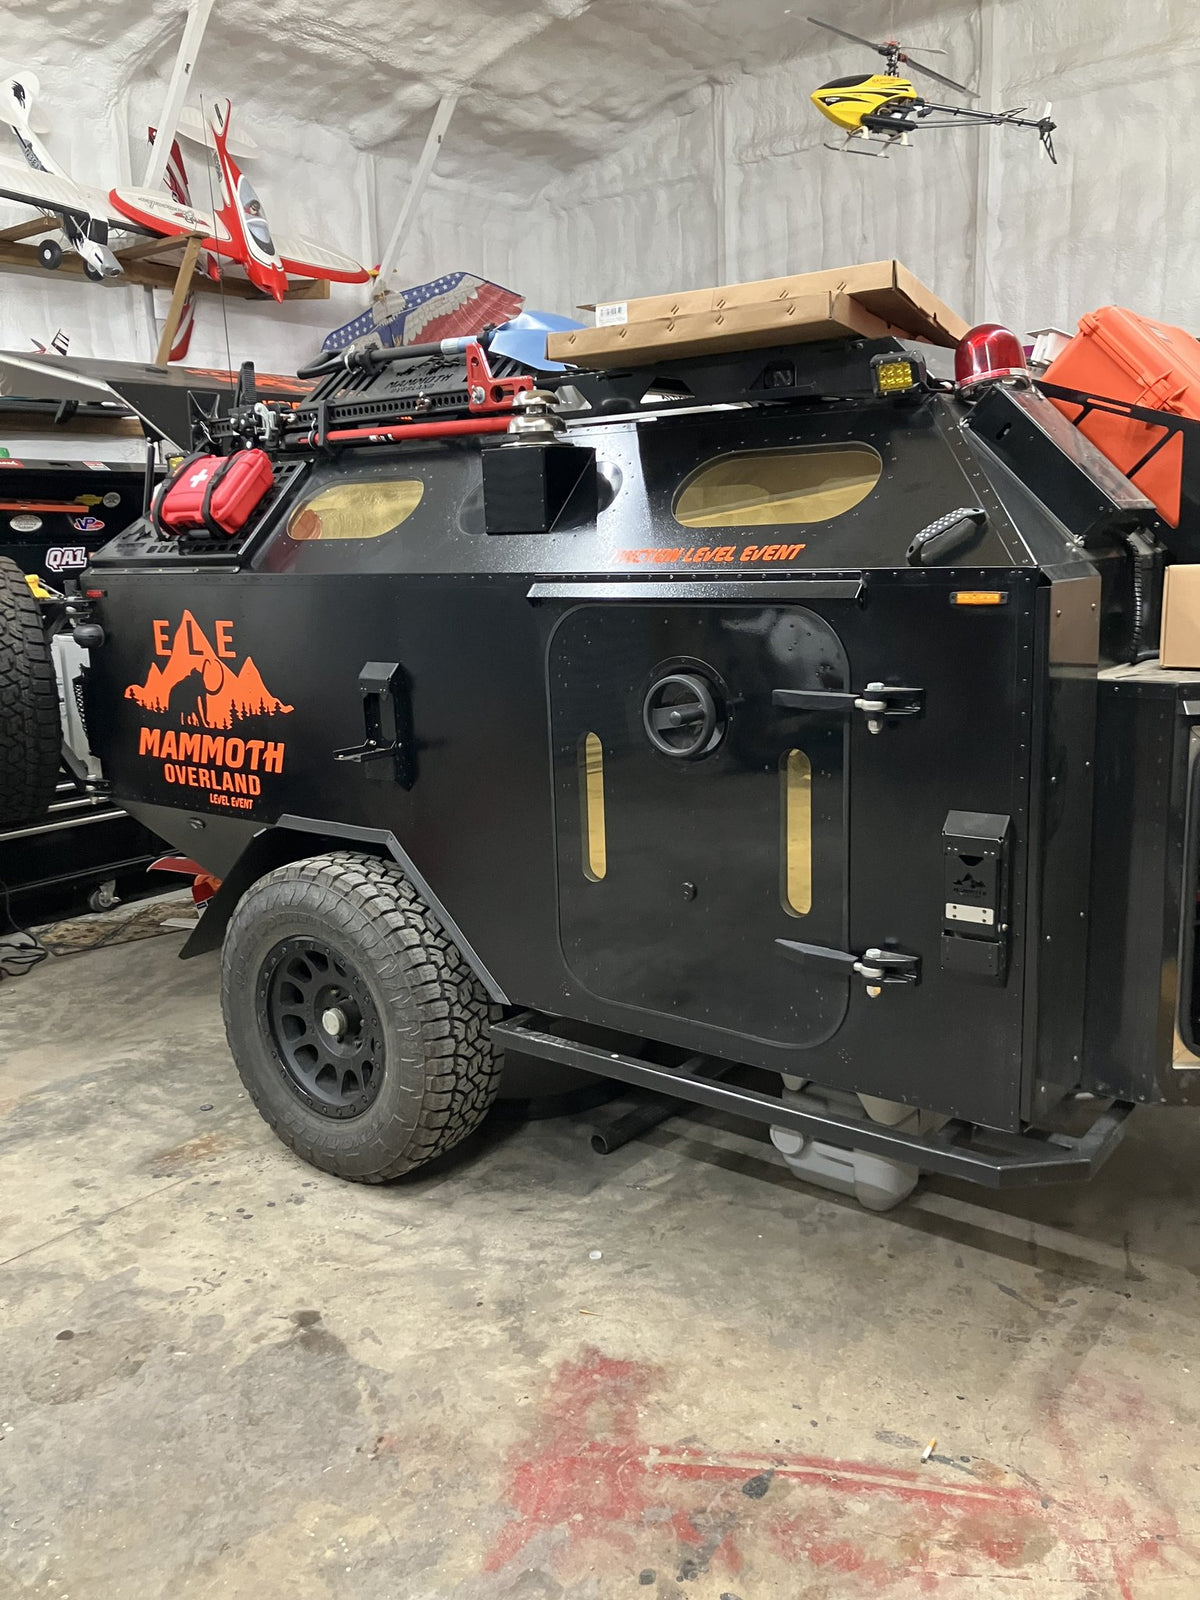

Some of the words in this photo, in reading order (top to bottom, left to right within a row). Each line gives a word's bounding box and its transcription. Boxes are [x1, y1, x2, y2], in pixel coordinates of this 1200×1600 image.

[75, 516, 97, 530] VP
[47, 548, 86, 571] QA1
[682, 546, 737, 563] LEVEL
[739, 544, 806, 562] EVENT
[138, 727, 286, 774] MAMMOTH
[164, 763, 262, 796] OVERLAND
[209, 793, 230, 806] LEVEL
[230, 796, 254, 810] EVENT
